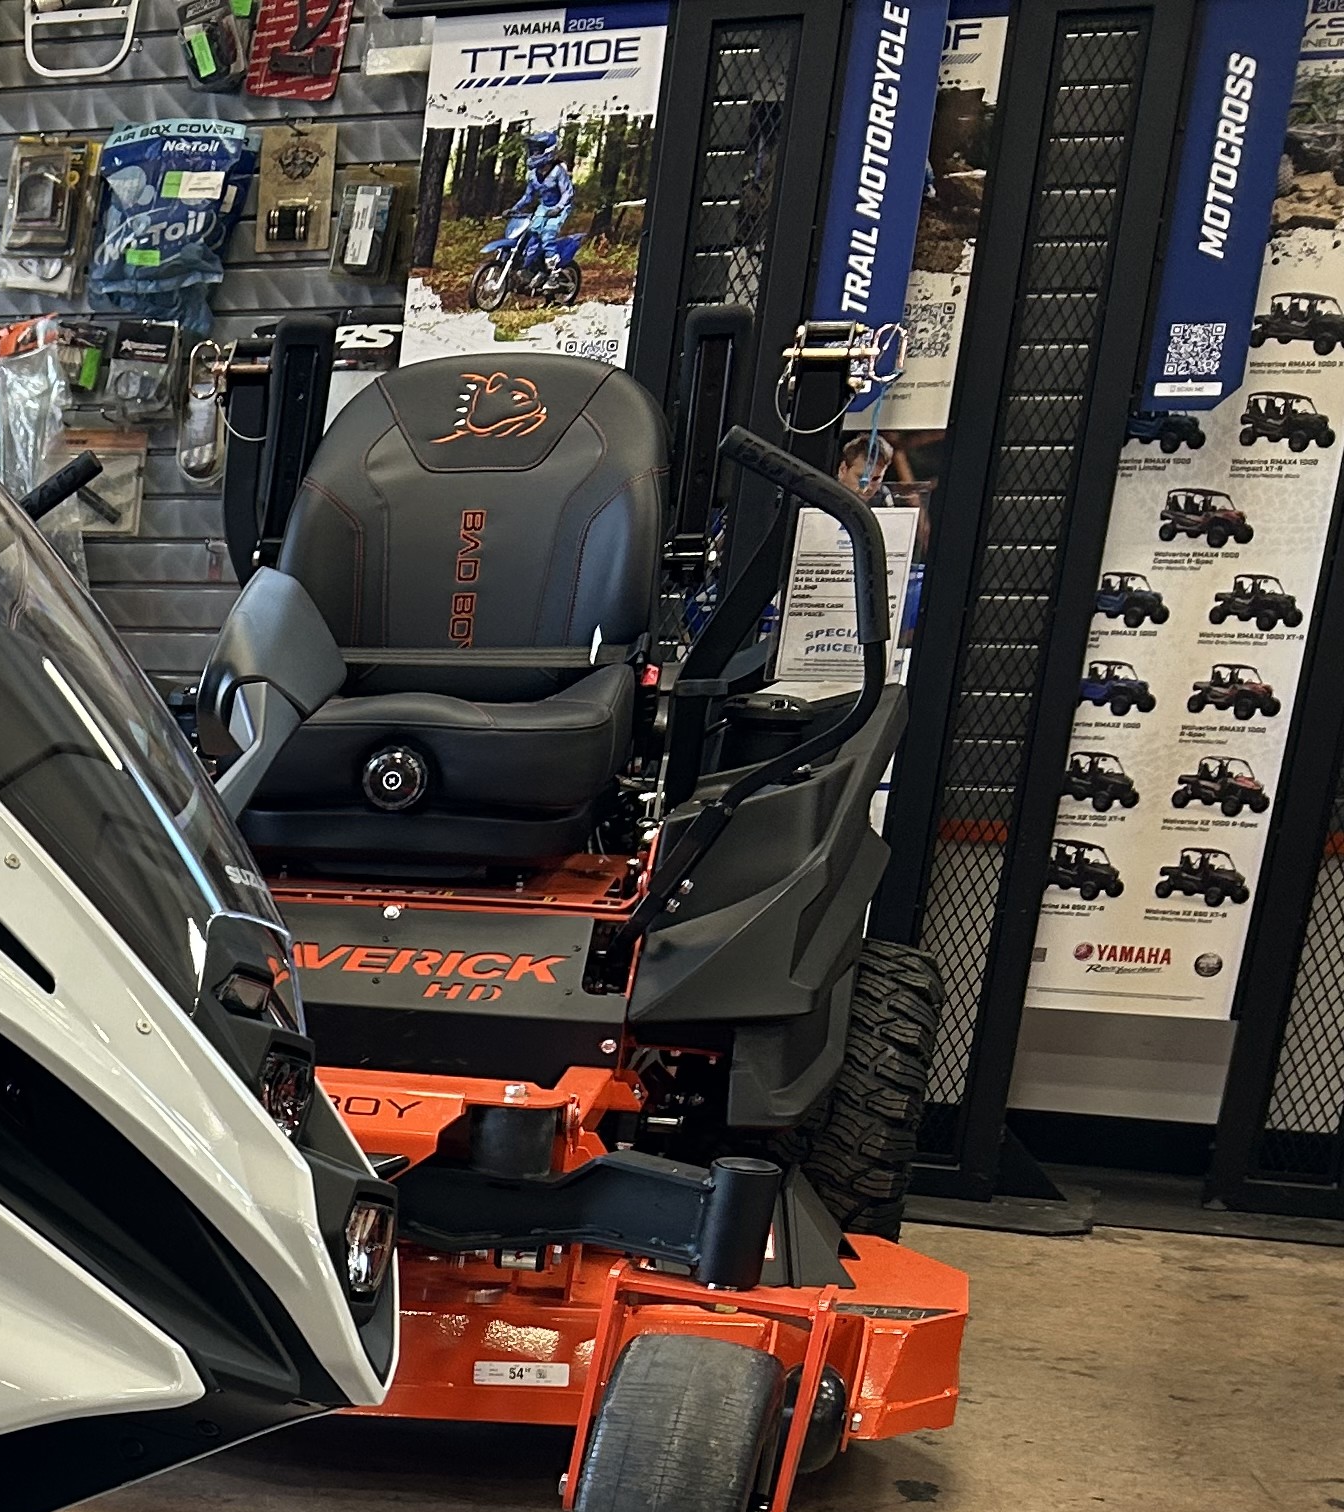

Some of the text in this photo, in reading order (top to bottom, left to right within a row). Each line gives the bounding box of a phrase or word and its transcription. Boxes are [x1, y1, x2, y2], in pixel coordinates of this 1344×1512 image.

[503, 17, 605, 37] YAMAHA 2025
[461, 37, 641, 74] TT-R110E
[113, 123, 236, 144] AIR BOX COVER
[841, 0, 910, 314] TRAIL MOTORCYCLE
[1198, 52, 1257, 259] MOTOCROSS
[456, 509, 487, 583] BAD
[291, 941, 571, 984] VERICK
[1097, 944, 1171, 965] YAMAHA
[423, 981, 502, 1001] HD
[509, 1367, 524, 1379] 54
